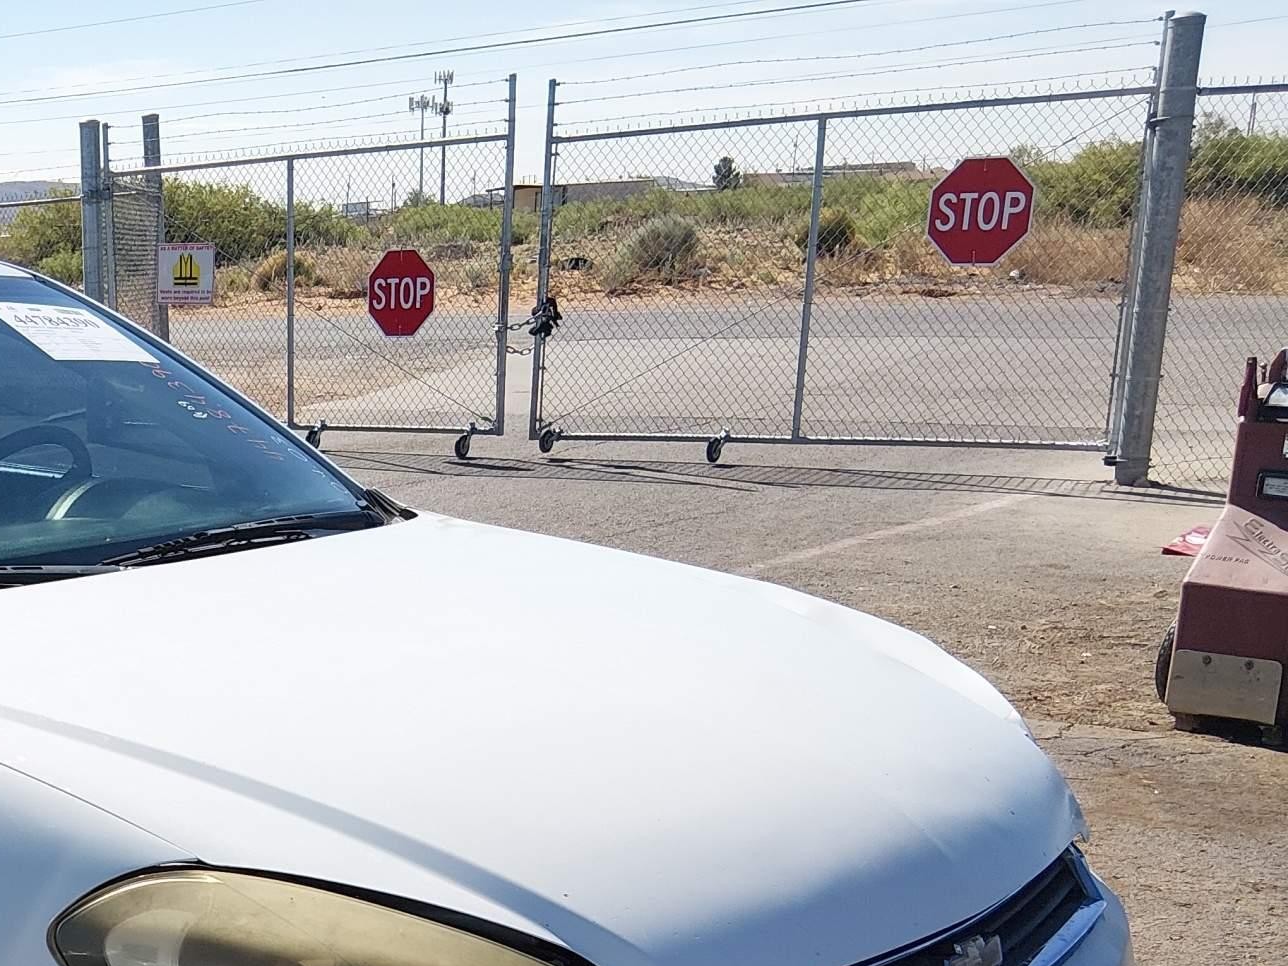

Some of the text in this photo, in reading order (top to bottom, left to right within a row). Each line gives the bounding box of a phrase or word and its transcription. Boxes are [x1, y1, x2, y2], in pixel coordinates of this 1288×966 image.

[934, 191, 1027, 232] STOP
[372, 276, 431, 310] STOP
[13, 313, 101, 329] 44784390
